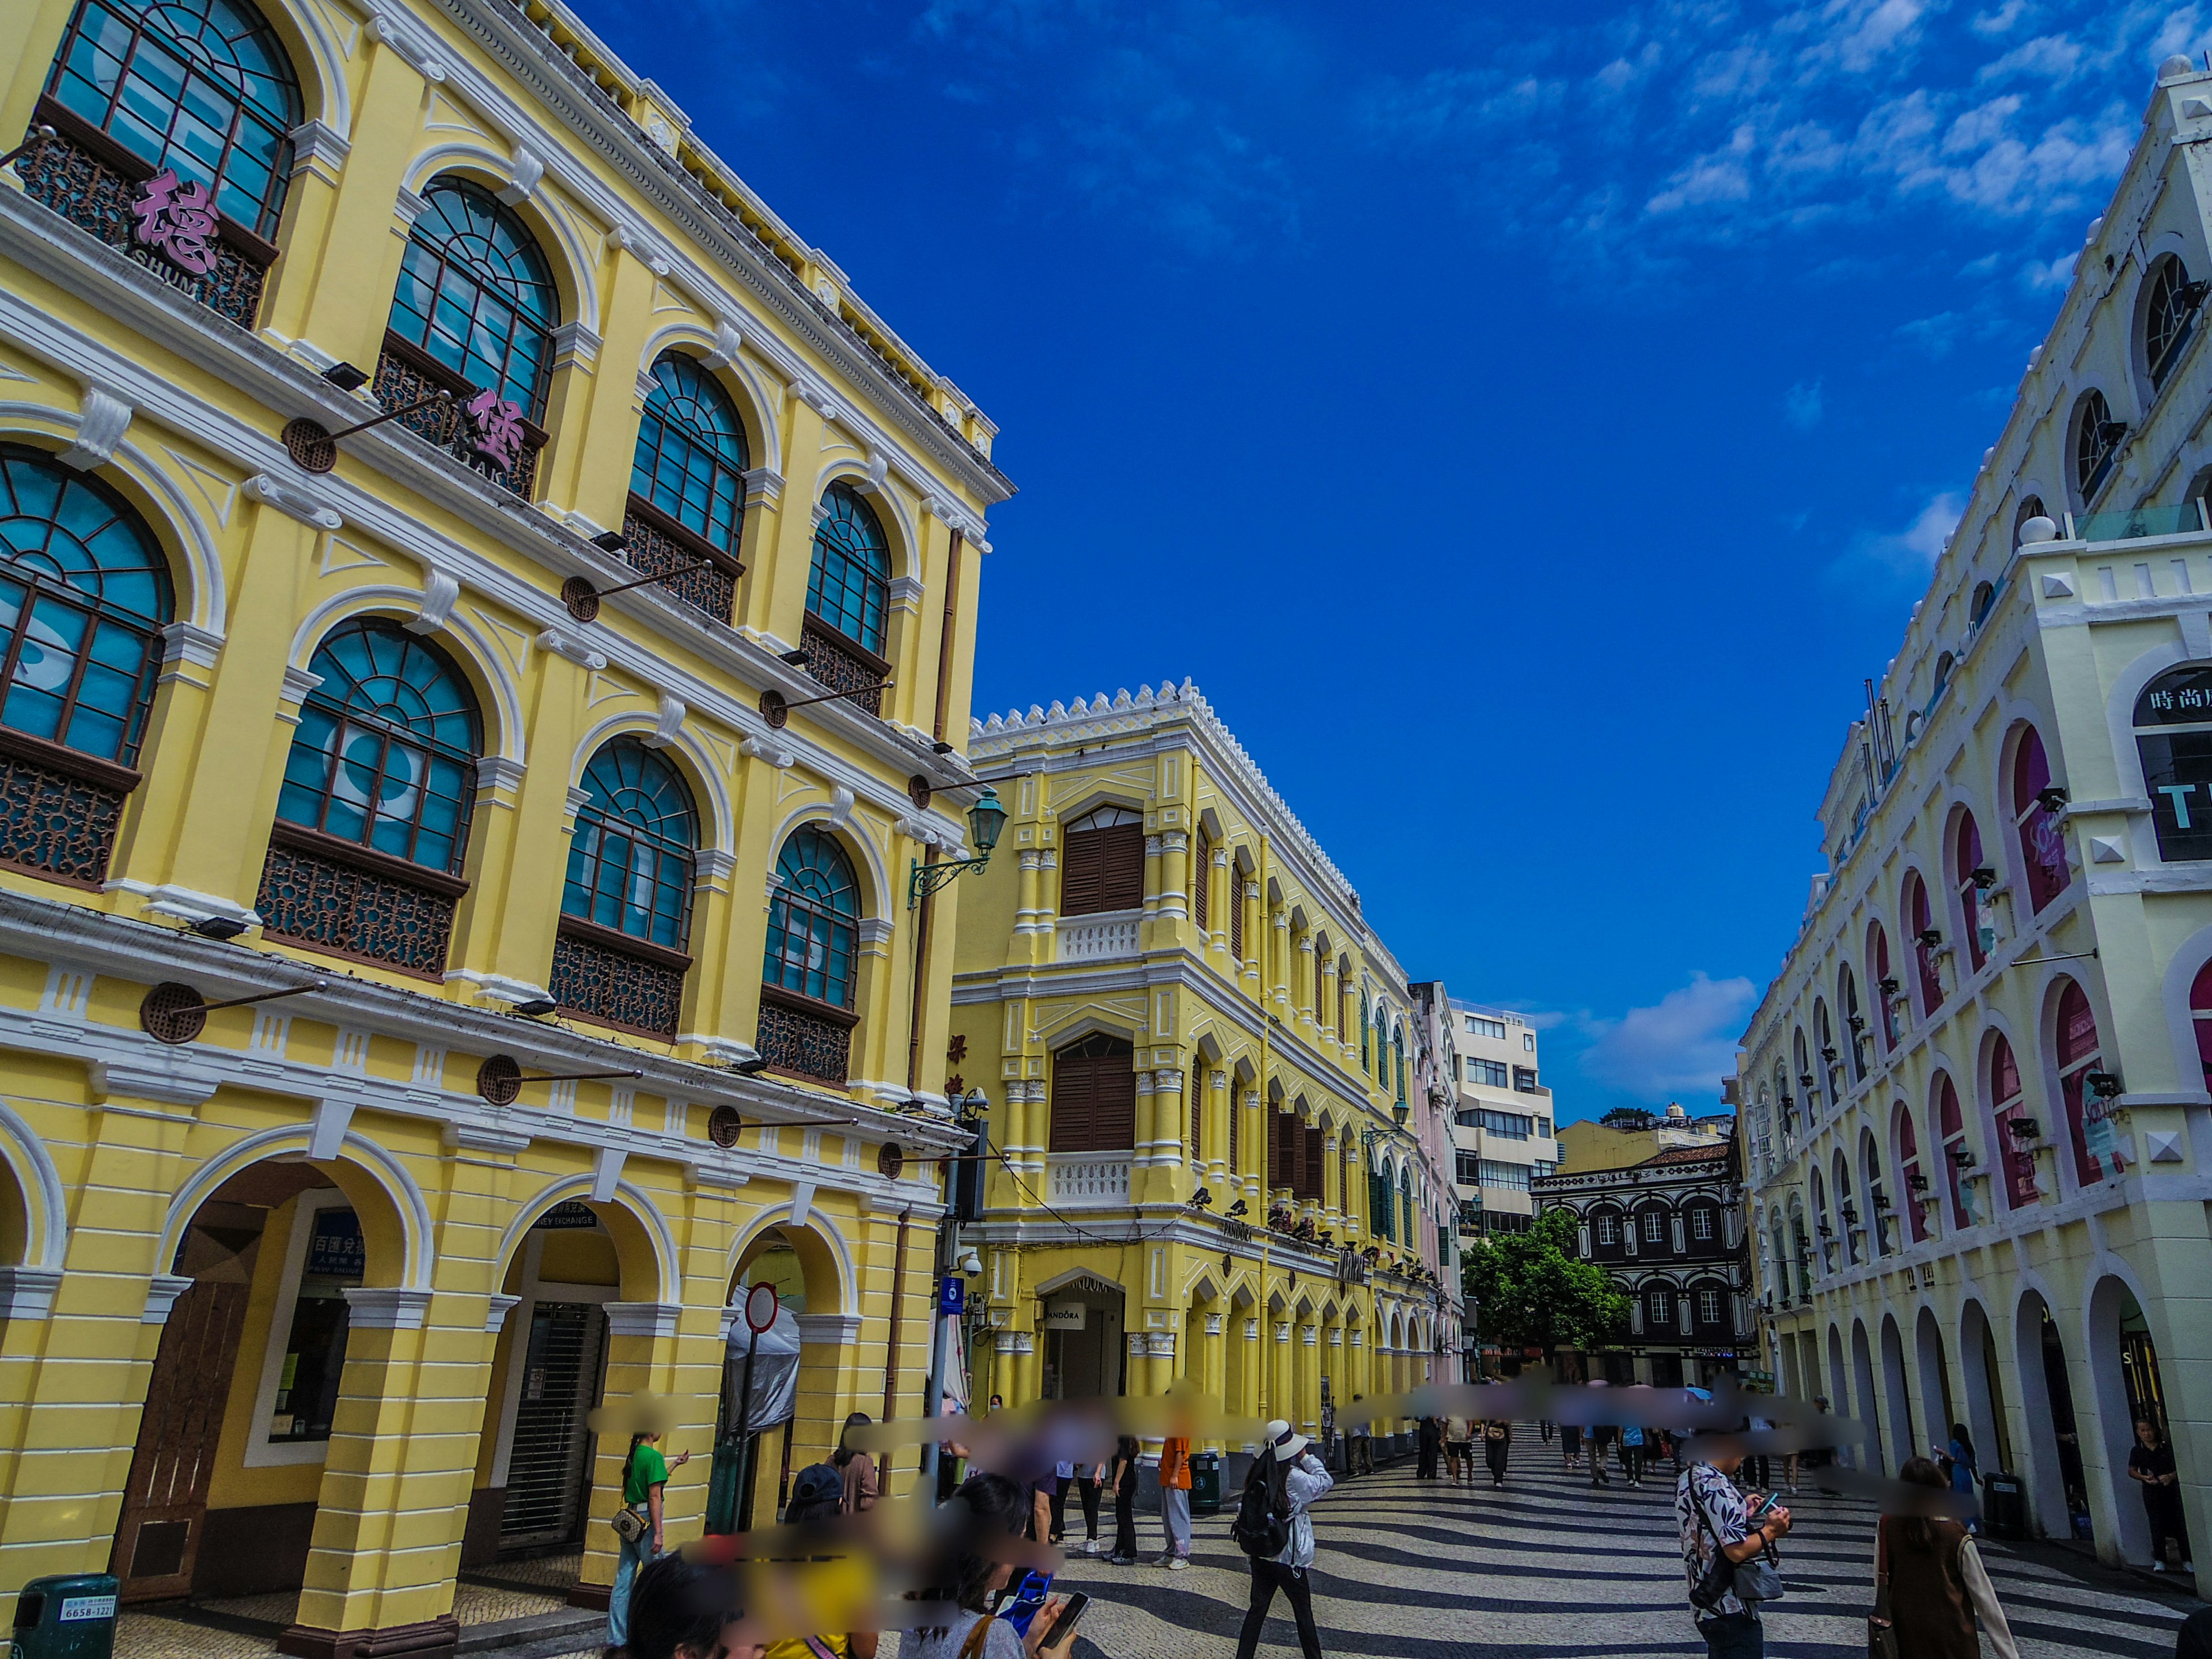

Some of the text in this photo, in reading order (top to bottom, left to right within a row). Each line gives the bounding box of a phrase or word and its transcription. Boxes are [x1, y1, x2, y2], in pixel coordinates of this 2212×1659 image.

[2150, 688, 2212, 710] 時尚
[2157, 784, 2212, 829] T
[534, 1215, 593, 1226] NEY EXCHANGE
[333, 1267, 364, 1275] MONE
[66, 1607, 112, 1618] 6658-1221
